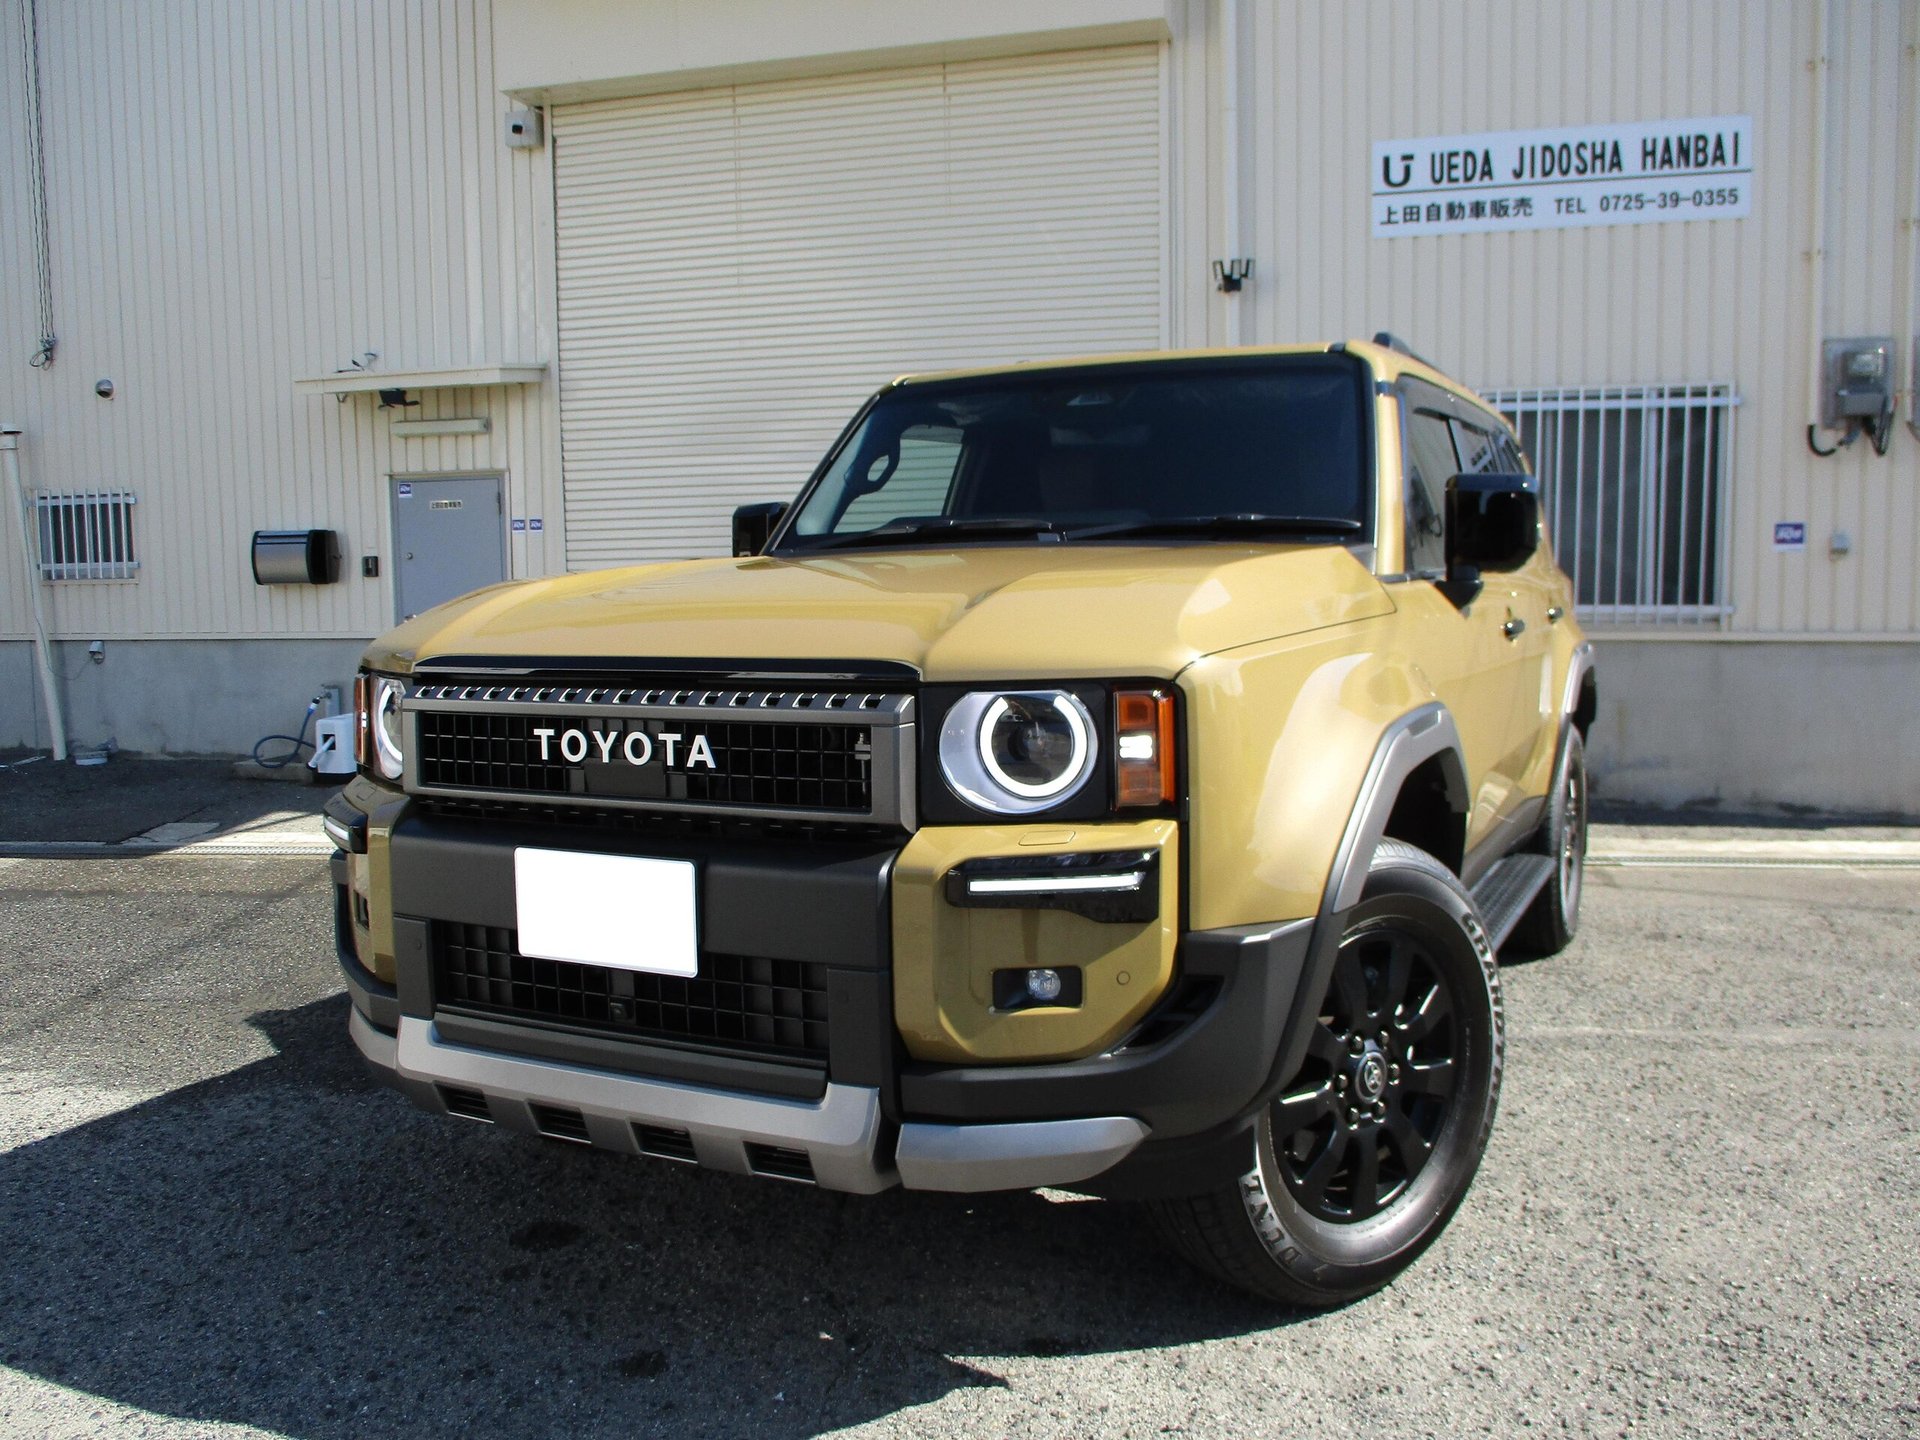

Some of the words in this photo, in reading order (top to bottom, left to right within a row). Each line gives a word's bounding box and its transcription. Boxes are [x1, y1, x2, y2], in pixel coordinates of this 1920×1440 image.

[1431, 150, 1494, 184] UEDA
[1512, 140, 1623, 180] JIDOSHA
[1641, 131, 1740, 170] HANBAI
[1380, 197, 1533, 225] 上田自動車販売
[1554, 198, 1586, 214] TEL
[1599, 188, 1739, 212] 0725-39-0355
[533, 728, 716, 769] TOYOTA
[1243, 1175, 1302, 1264] DUNL
